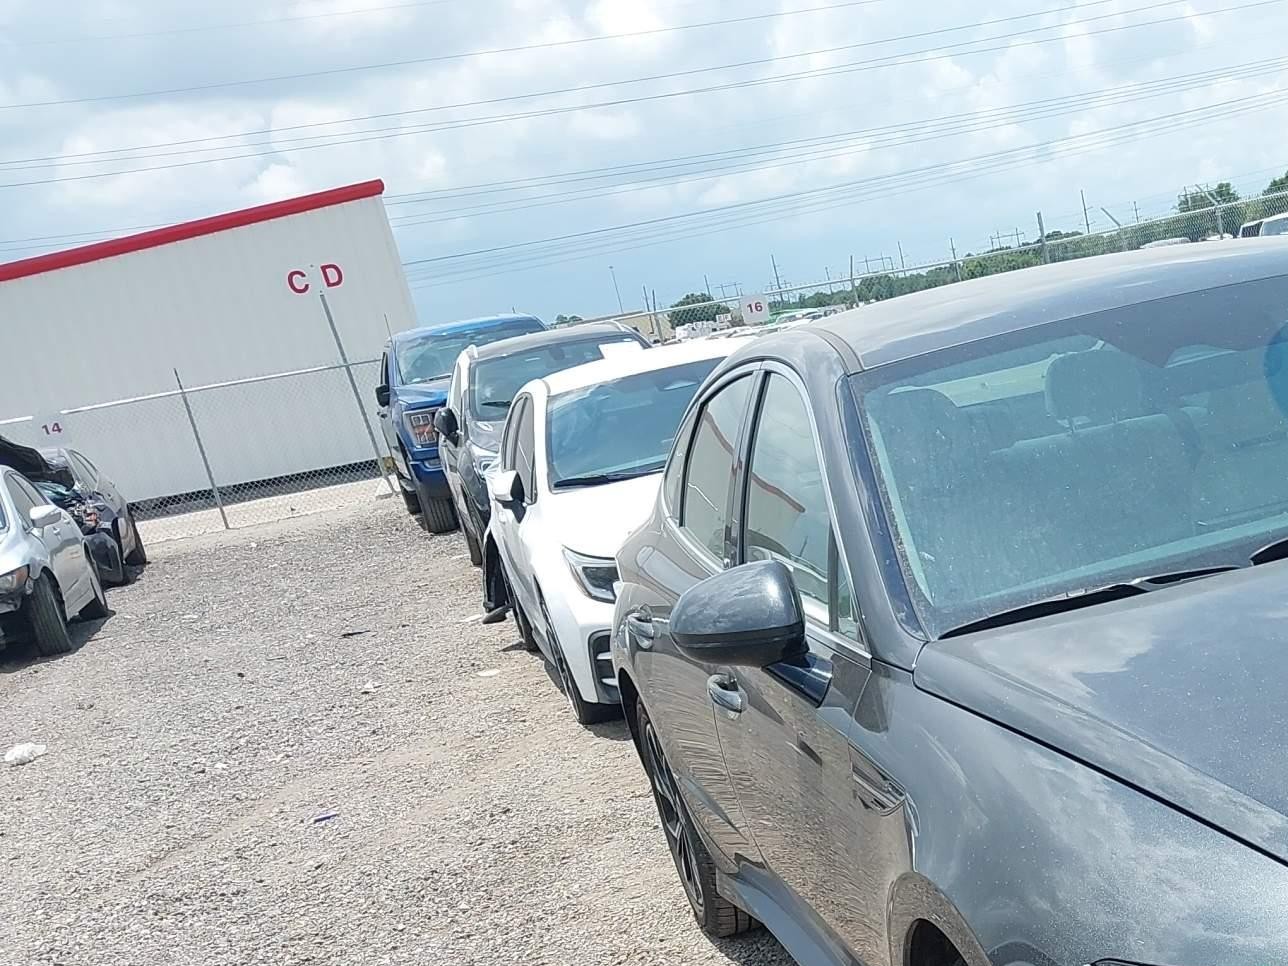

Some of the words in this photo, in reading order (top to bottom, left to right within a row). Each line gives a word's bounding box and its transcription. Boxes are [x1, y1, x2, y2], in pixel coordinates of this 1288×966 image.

[287, 270, 310, 294] C
[320, 263, 343, 287] D
[746, 301, 763, 313] 16
[41, 422, 63, 435] 14
